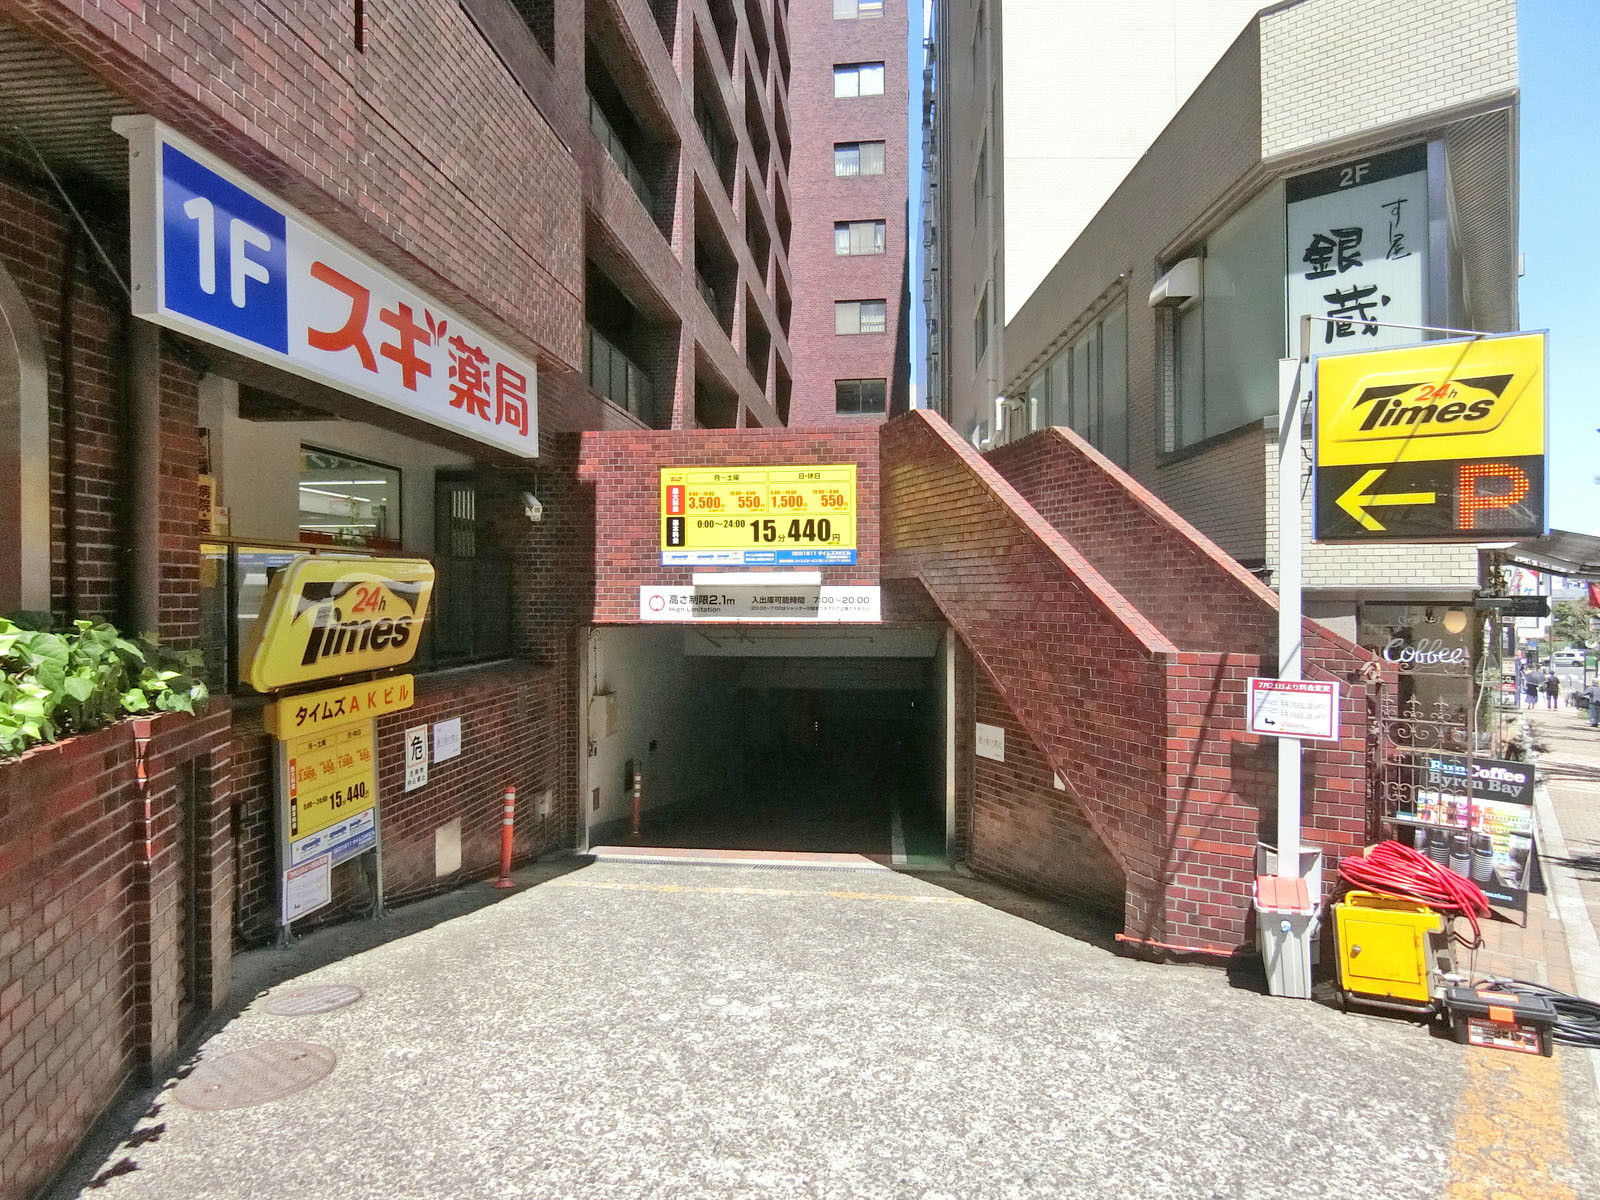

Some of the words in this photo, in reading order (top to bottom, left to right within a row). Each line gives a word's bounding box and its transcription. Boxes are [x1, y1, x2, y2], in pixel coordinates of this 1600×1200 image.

[1339, 163, 1370, 187] 2F
[1382, 198, 1412, 260] すし屋
[183, 197, 271, 309] 1F
[307, 260, 529, 437] スギ薬局
[1354, 382, 1506, 431] Times
[1458, 463, 1530, 530] P
[351, 586, 386, 613] 24h
[751, 596, 806, 605] 入出庫可能時間
[291, 582, 421, 666] Times
[1383, 637, 1465, 664] Coffee
[410, 735, 423, 761] 危
[1429, 771, 1484, 790] Byron
[1487, 779, 1524, 798] Bay
